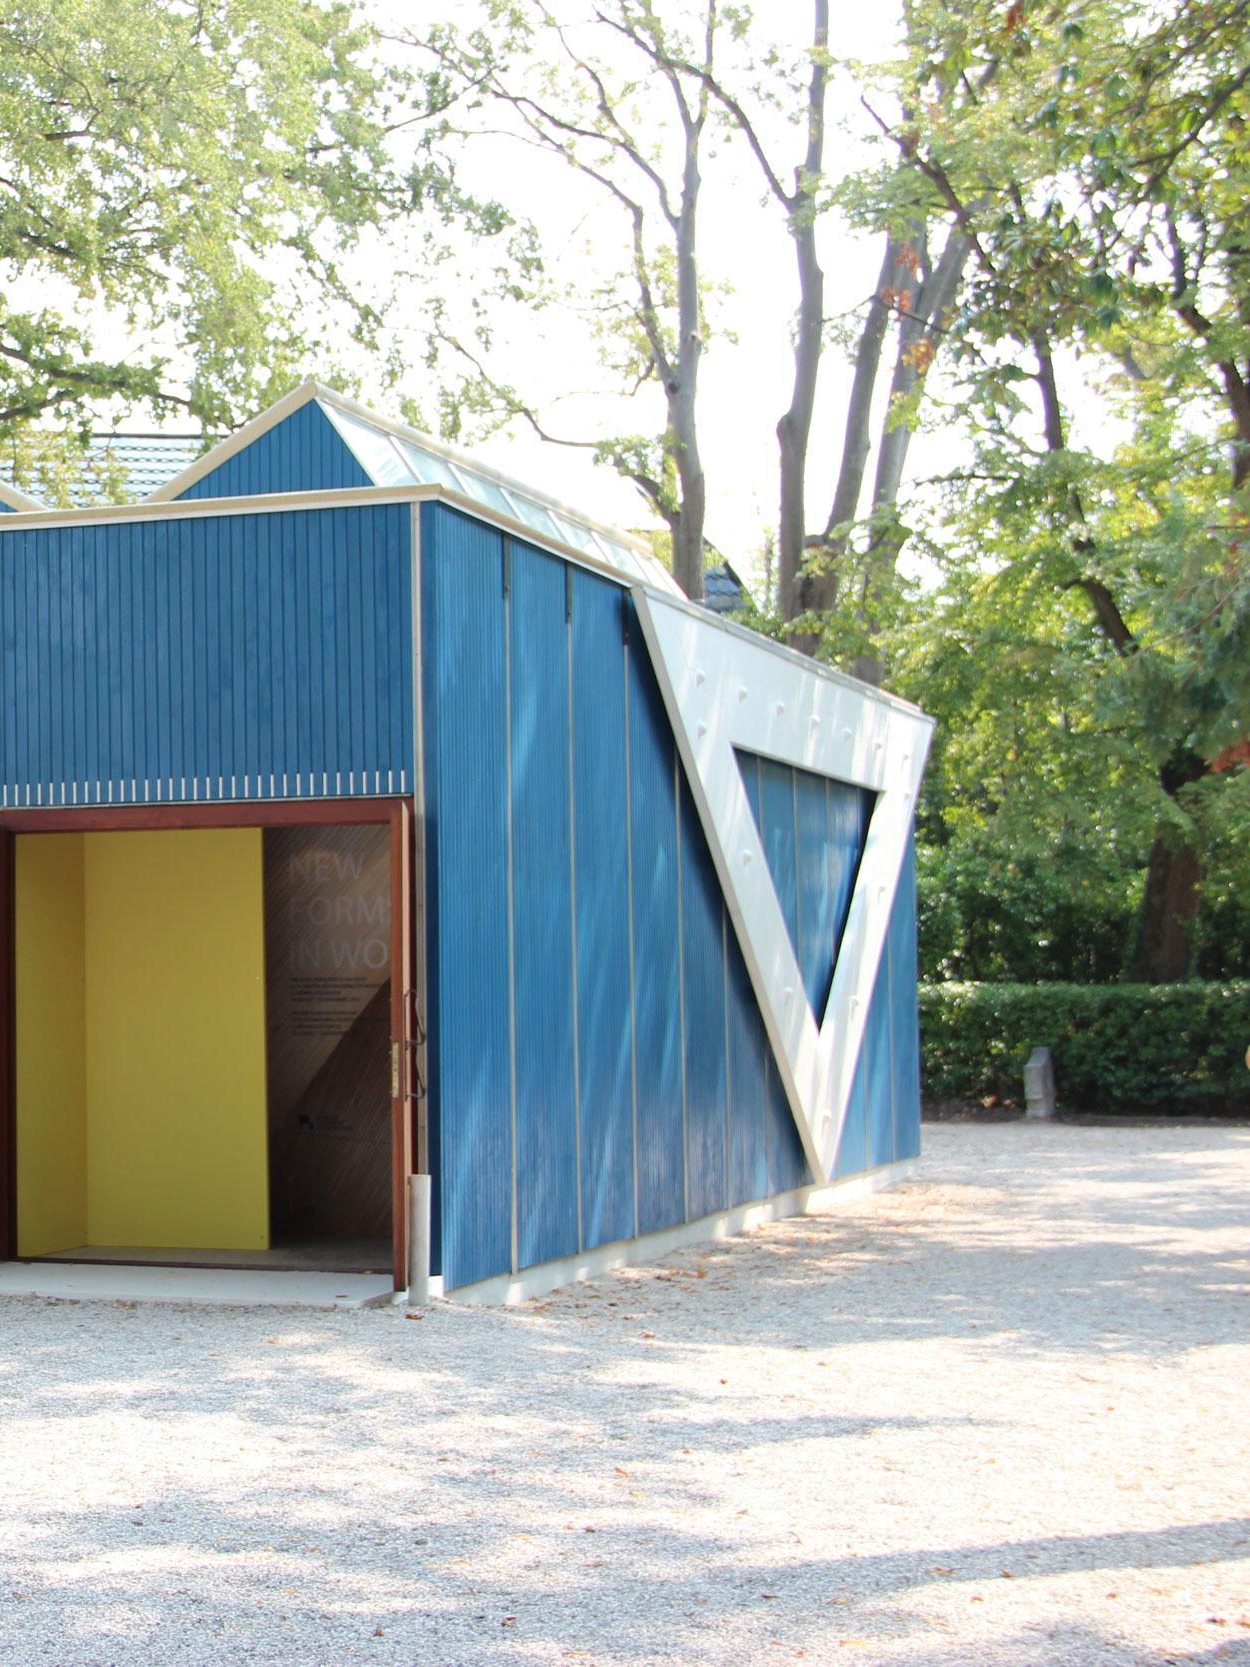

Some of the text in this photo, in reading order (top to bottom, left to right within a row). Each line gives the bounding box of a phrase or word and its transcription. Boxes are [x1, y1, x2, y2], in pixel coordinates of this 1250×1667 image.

[289, 851, 365, 880] NEW
[289, 896, 390, 925] FORM
[289, 938, 388, 969] IN WO
